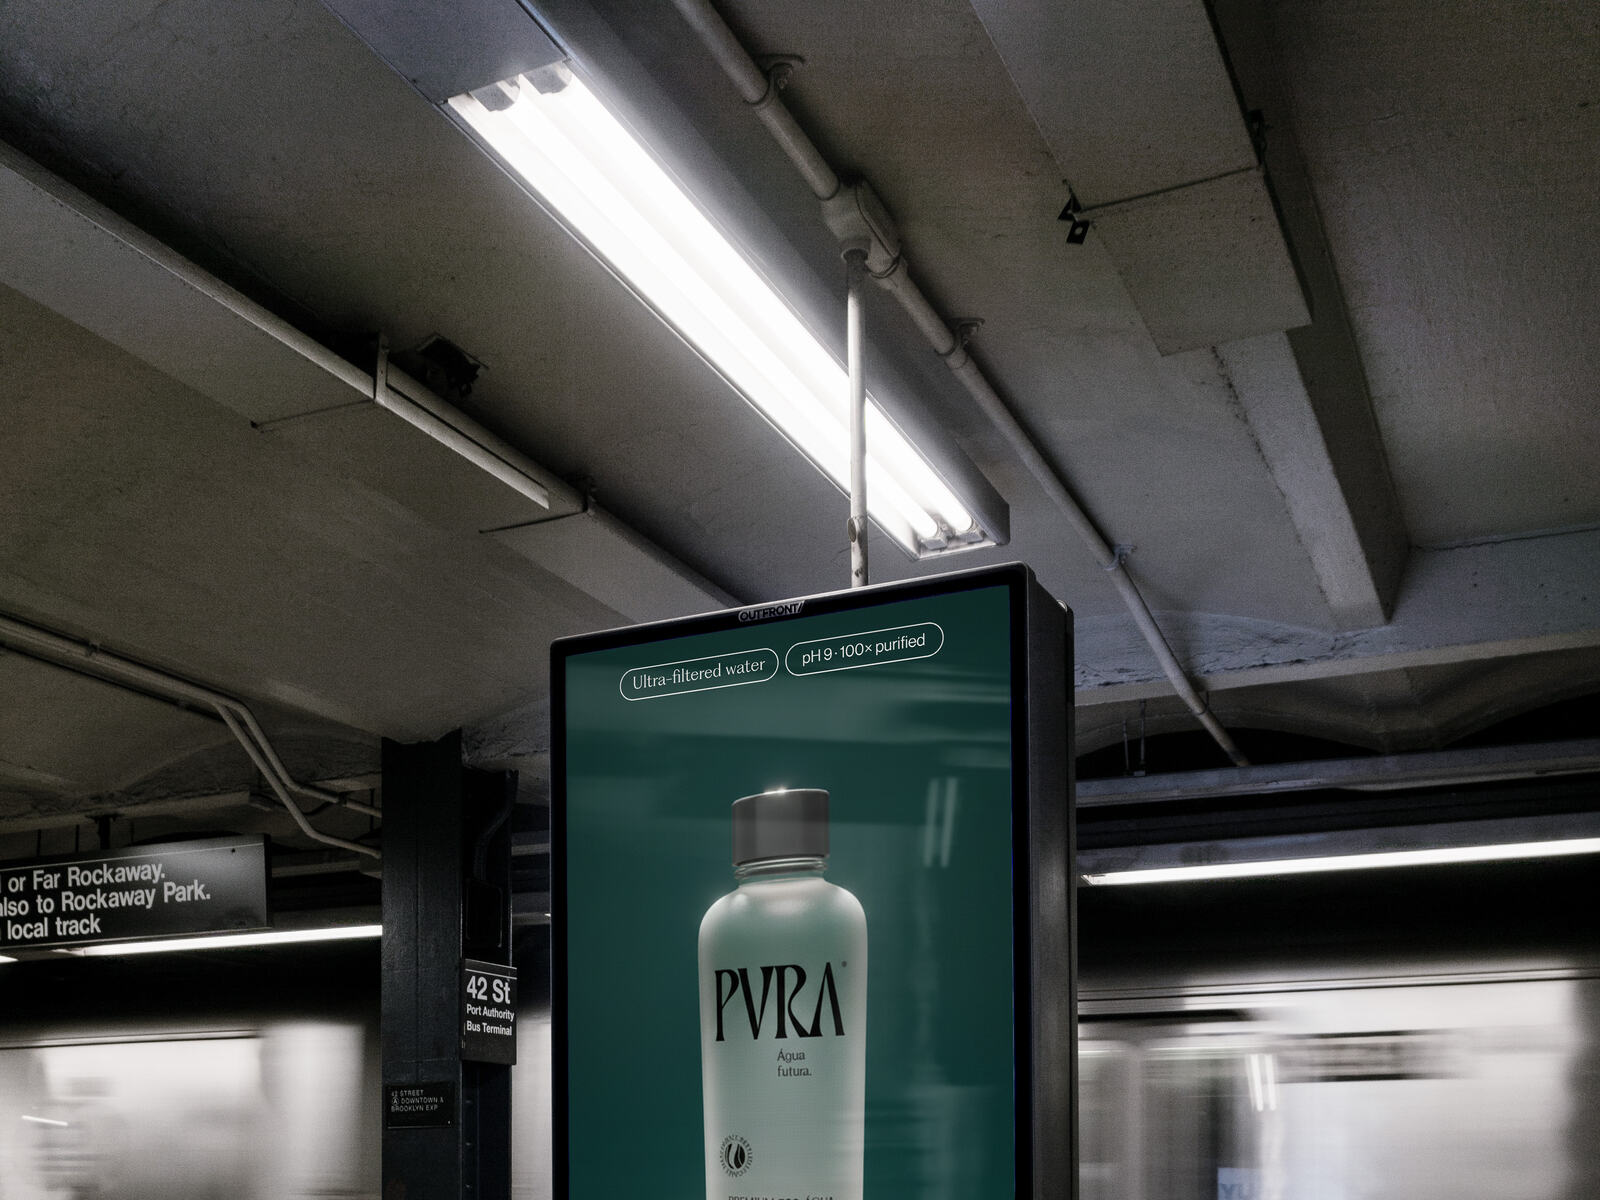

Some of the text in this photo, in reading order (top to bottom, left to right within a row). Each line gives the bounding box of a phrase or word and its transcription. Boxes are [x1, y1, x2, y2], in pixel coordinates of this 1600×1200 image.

[802, 649, 821, 667] pH
[875, 632, 925, 655] purified
[633, 658, 766, 690] Ultra-filtered water
[8, 863, 165, 892] or Far Rockaway.
[36, 894, 55, 914] to
[62, 888, 156, 910] Rockaway
[163, 879, 211, 903] Park.
[8, 913, 101, 940] local track
[466, 975, 511, 1005] 42 St
[466, 1003, 515, 1022] Port Authority
[466, 1020, 513, 1037] Bus Terminal
[777, 1048, 806, 1064] Água
[777, 1065, 812, 1077] futura.
[400, 1089, 424, 1097] STREET
[401, 1096, 438, 1104] DOWNTOWN
[391, 1104, 424, 1112] BROOKLYN
